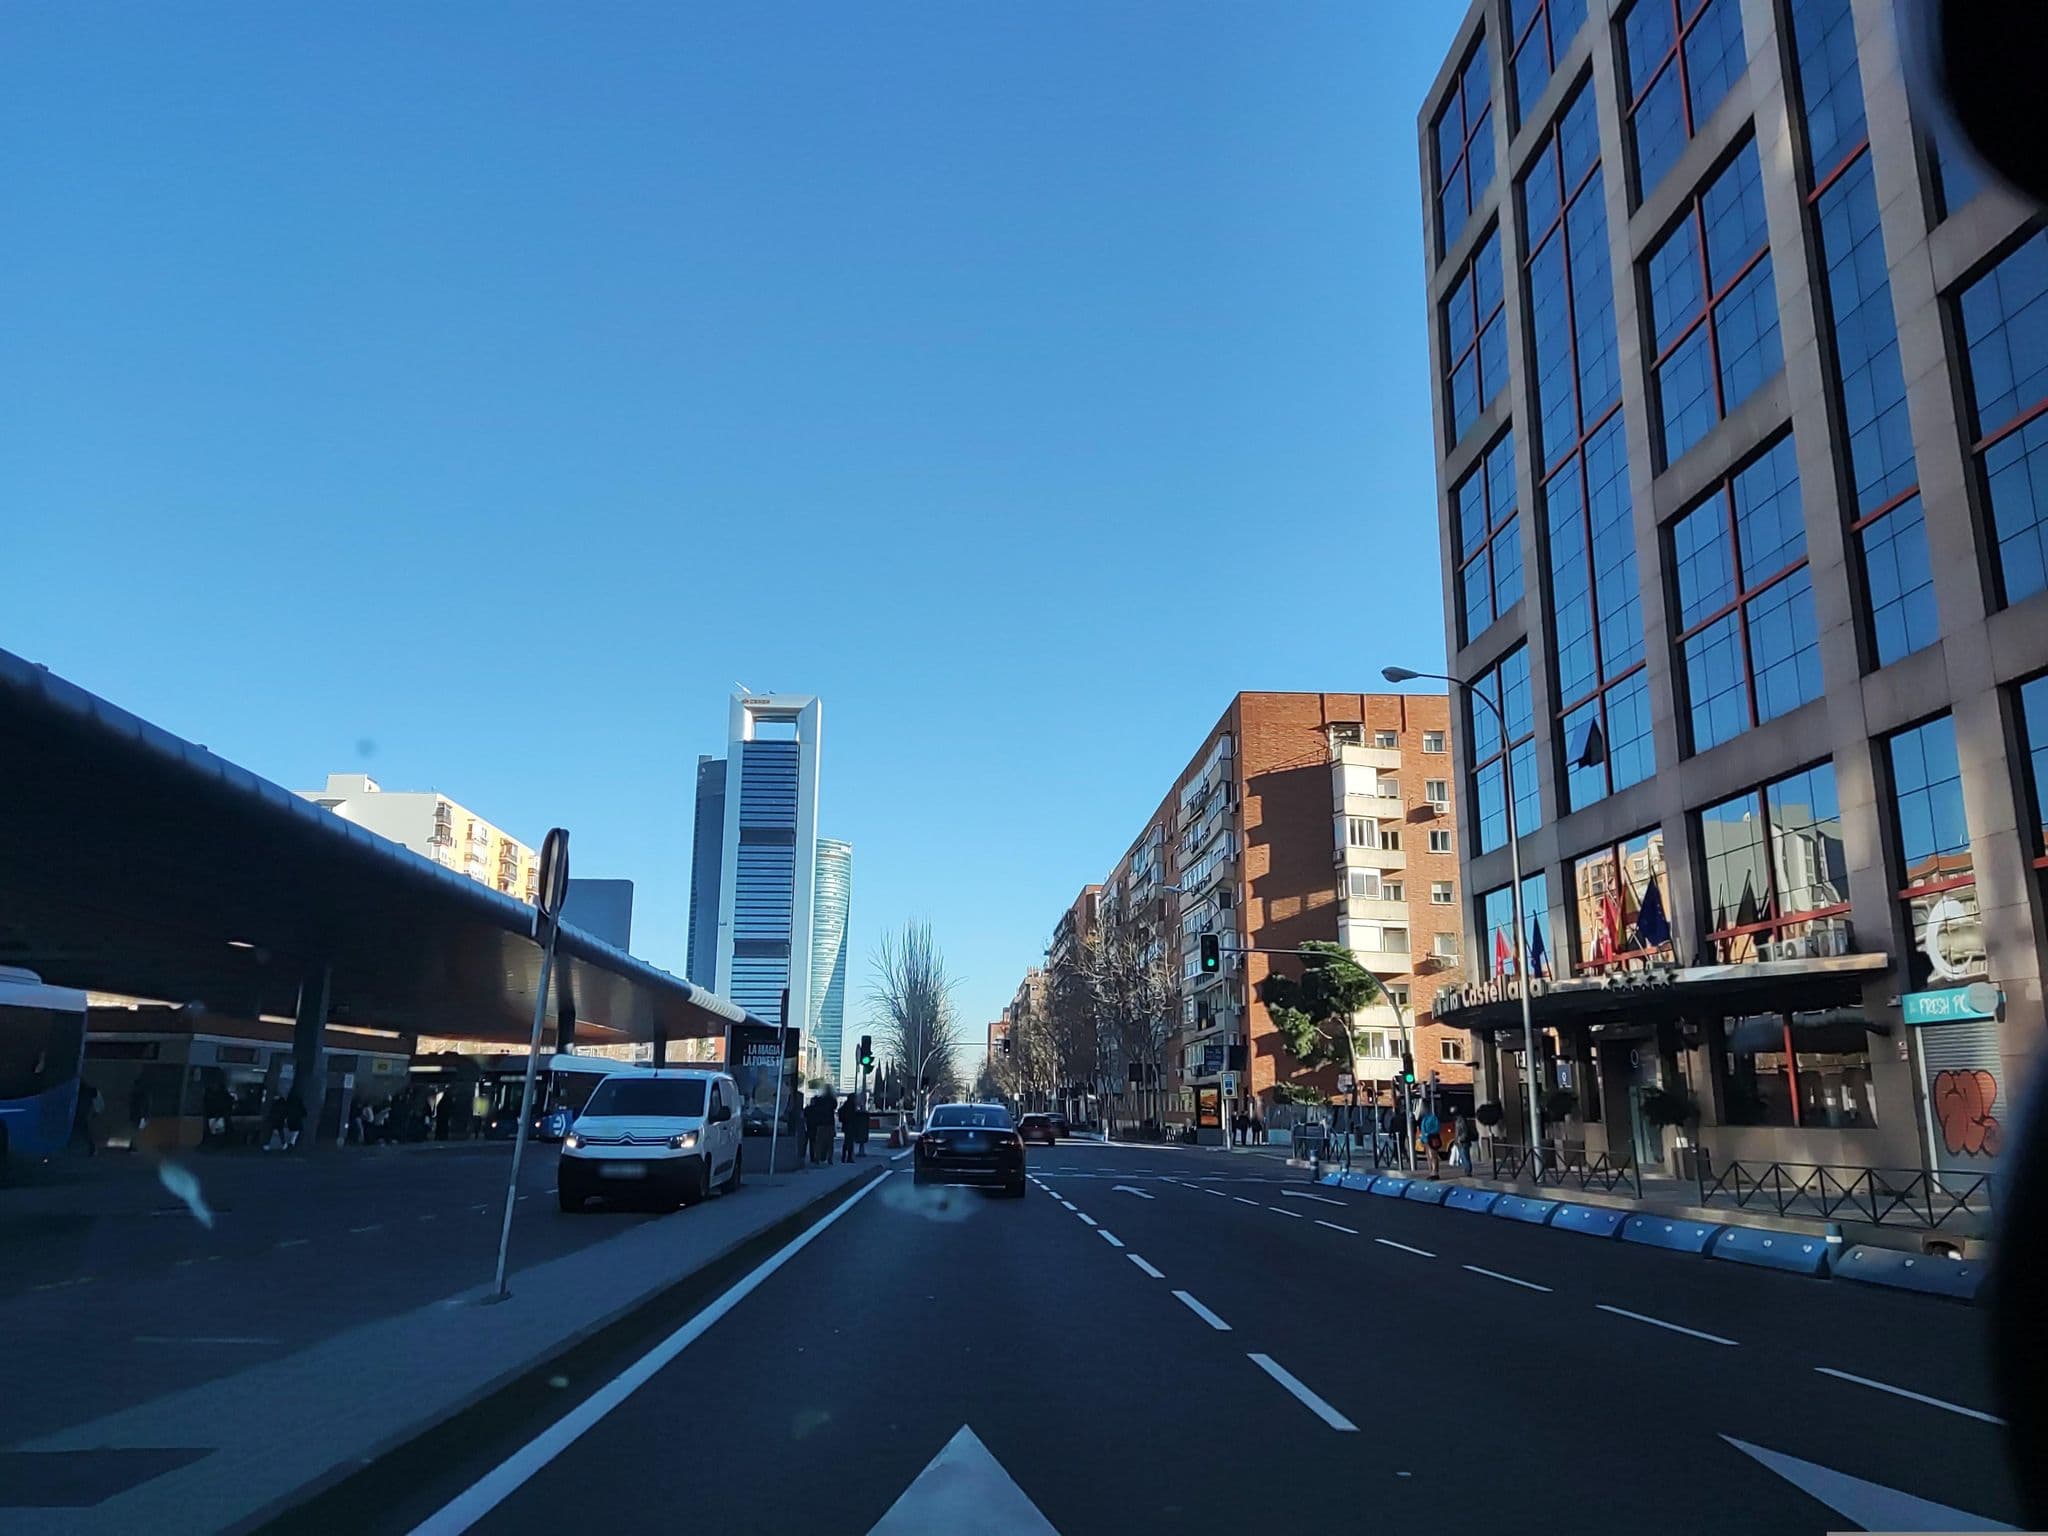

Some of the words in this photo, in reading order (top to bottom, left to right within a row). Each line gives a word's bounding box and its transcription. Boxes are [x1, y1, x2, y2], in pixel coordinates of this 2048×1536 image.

[1461, 978, 1545, 1008] Castellana
[1919, 996, 1950, 1016] FRESH
[748, 1044, 757, 1055] LA
